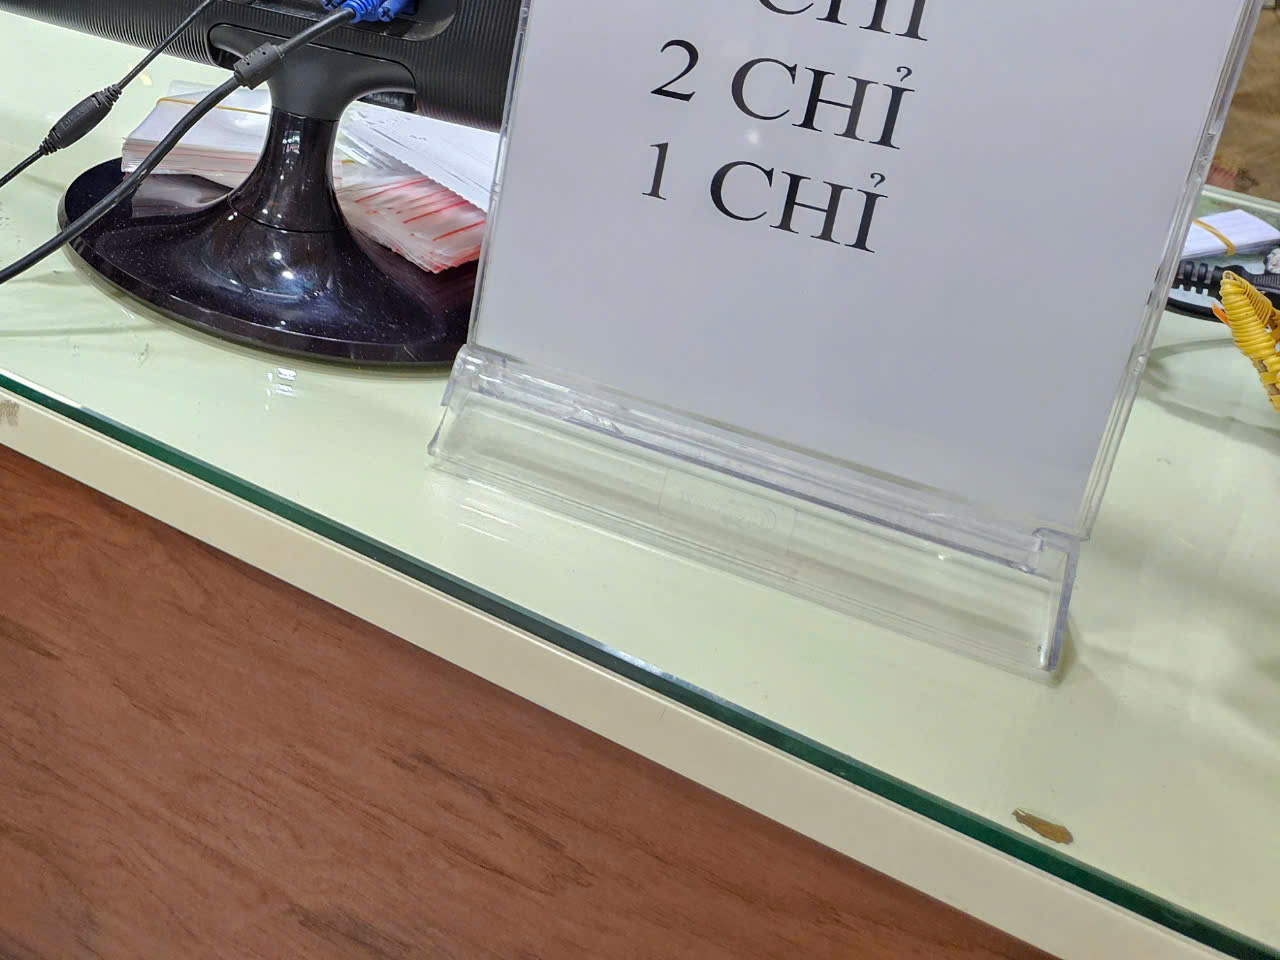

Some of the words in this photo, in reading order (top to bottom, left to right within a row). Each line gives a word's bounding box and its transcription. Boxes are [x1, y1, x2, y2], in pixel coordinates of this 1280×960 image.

[651, 40, 698, 101] 2
[732, 58, 915, 150] CHỈ
[642, 143, 668, 200] 1
[710, 161, 888, 253] CHỈ
